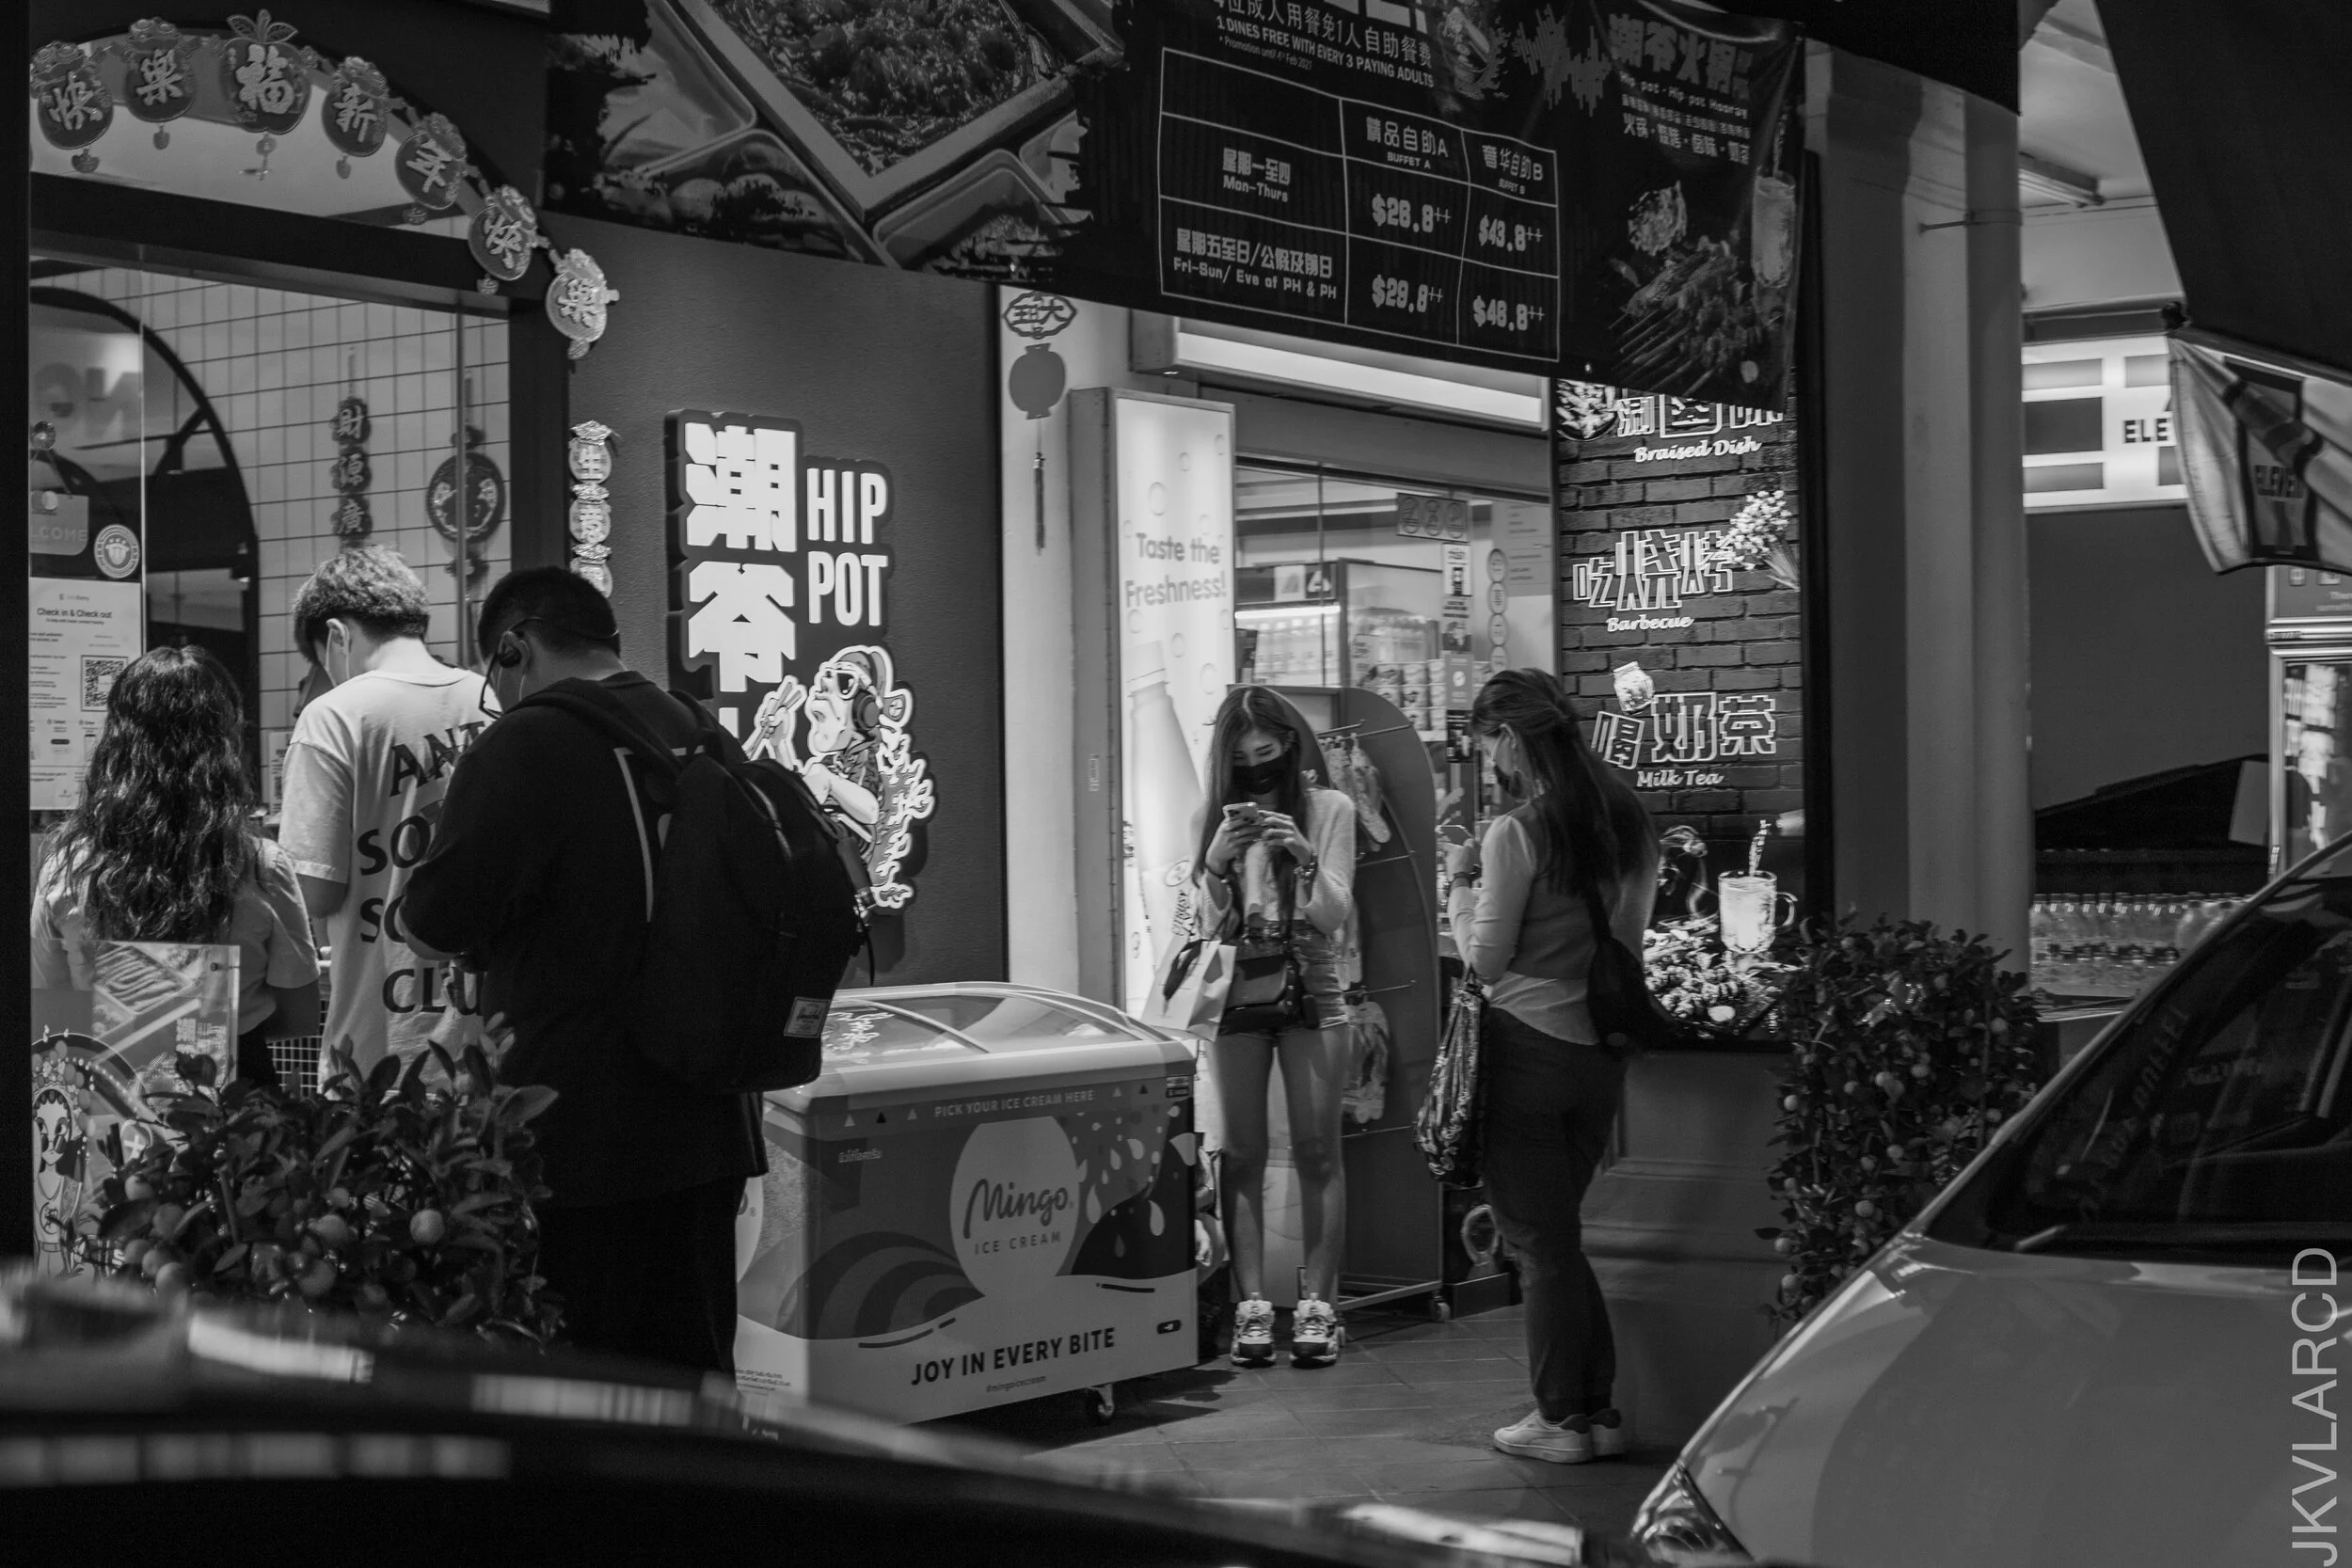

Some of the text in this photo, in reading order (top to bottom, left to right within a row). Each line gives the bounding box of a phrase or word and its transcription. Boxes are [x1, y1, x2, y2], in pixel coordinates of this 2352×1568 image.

[1216, 0, 1432, 69] 位成人用餐免1人自助餐费
[1226, 17, 1260, 40] DINES
[1262, 27, 1290, 48] FREE
[1291, 35, 1316, 56] WITH
[1317, 43, 1344, 69] EVERY
[1345, 53, 1355, 69] 3
[1356, 55, 1395, 79] PAYING
[1396, 66, 1435, 88] ADULTS
[237, 43, 294, 115] 福
[1386, 150, 1432, 169] BUFFET A
[1222, 174, 1289, 203] Mon-Thurs
[1235, 268, 1260, 286] Eve
[1264, 275, 1279, 289] of
[1282, 277, 1302, 293] PH
[1306, 280, 1316, 297] &
[1320, 283, 1338, 300] PH
[1632, 436, 1762, 463] Braised Dish
[806, 467, 888, 545] HIP
[1135, 531, 1220, 565] Taste the
[684, 421, 797, 743] 潮爷
[807, 550, 889, 626] POT
[1125, 570, 1228, 609] Freshness!
[1605, 614, 1695, 632] Barbecue
[1636, 768, 1724, 788] Milk Tea
[934, 1090, 1095, 1117] PICK YOUR ICE CREAM HERE
[963, 1178, 1069, 1239] Mingo
[974, 1231, 1062, 1257] ICE CREAM
[911, 1326, 1116, 1386] JOY IN EVERY BITE
